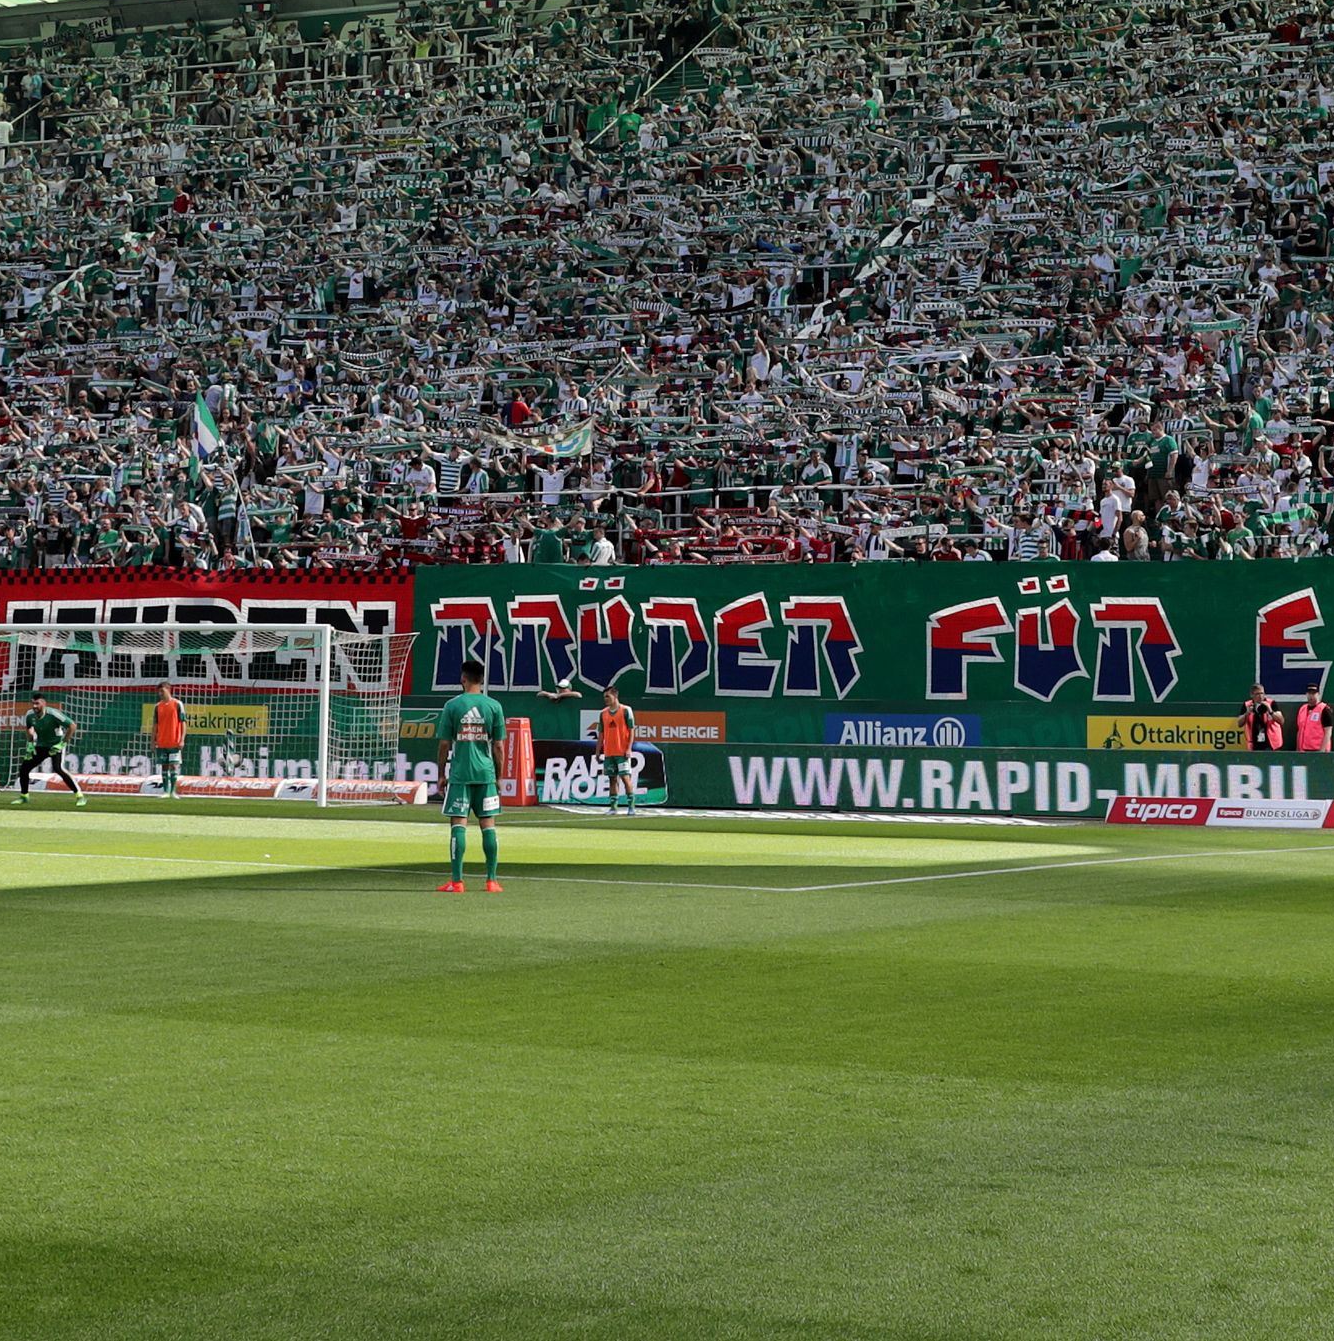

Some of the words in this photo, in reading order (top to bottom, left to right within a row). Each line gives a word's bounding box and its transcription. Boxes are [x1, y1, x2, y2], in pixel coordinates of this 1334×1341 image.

[430, 576, 864, 701] BRÜDER
[926, 574, 1183, 703] FÜR
[185, 712, 260, 732] ttakringer
[661, 725, 719, 739] ENERGIE
[839, 720, 927, 746] Allianz
[1130, 722, 1245, 749] Ottakringer
[1125, 798, 1198, 822] tipico
[1245, 810, 1310, 819] BUNDESLIGA
